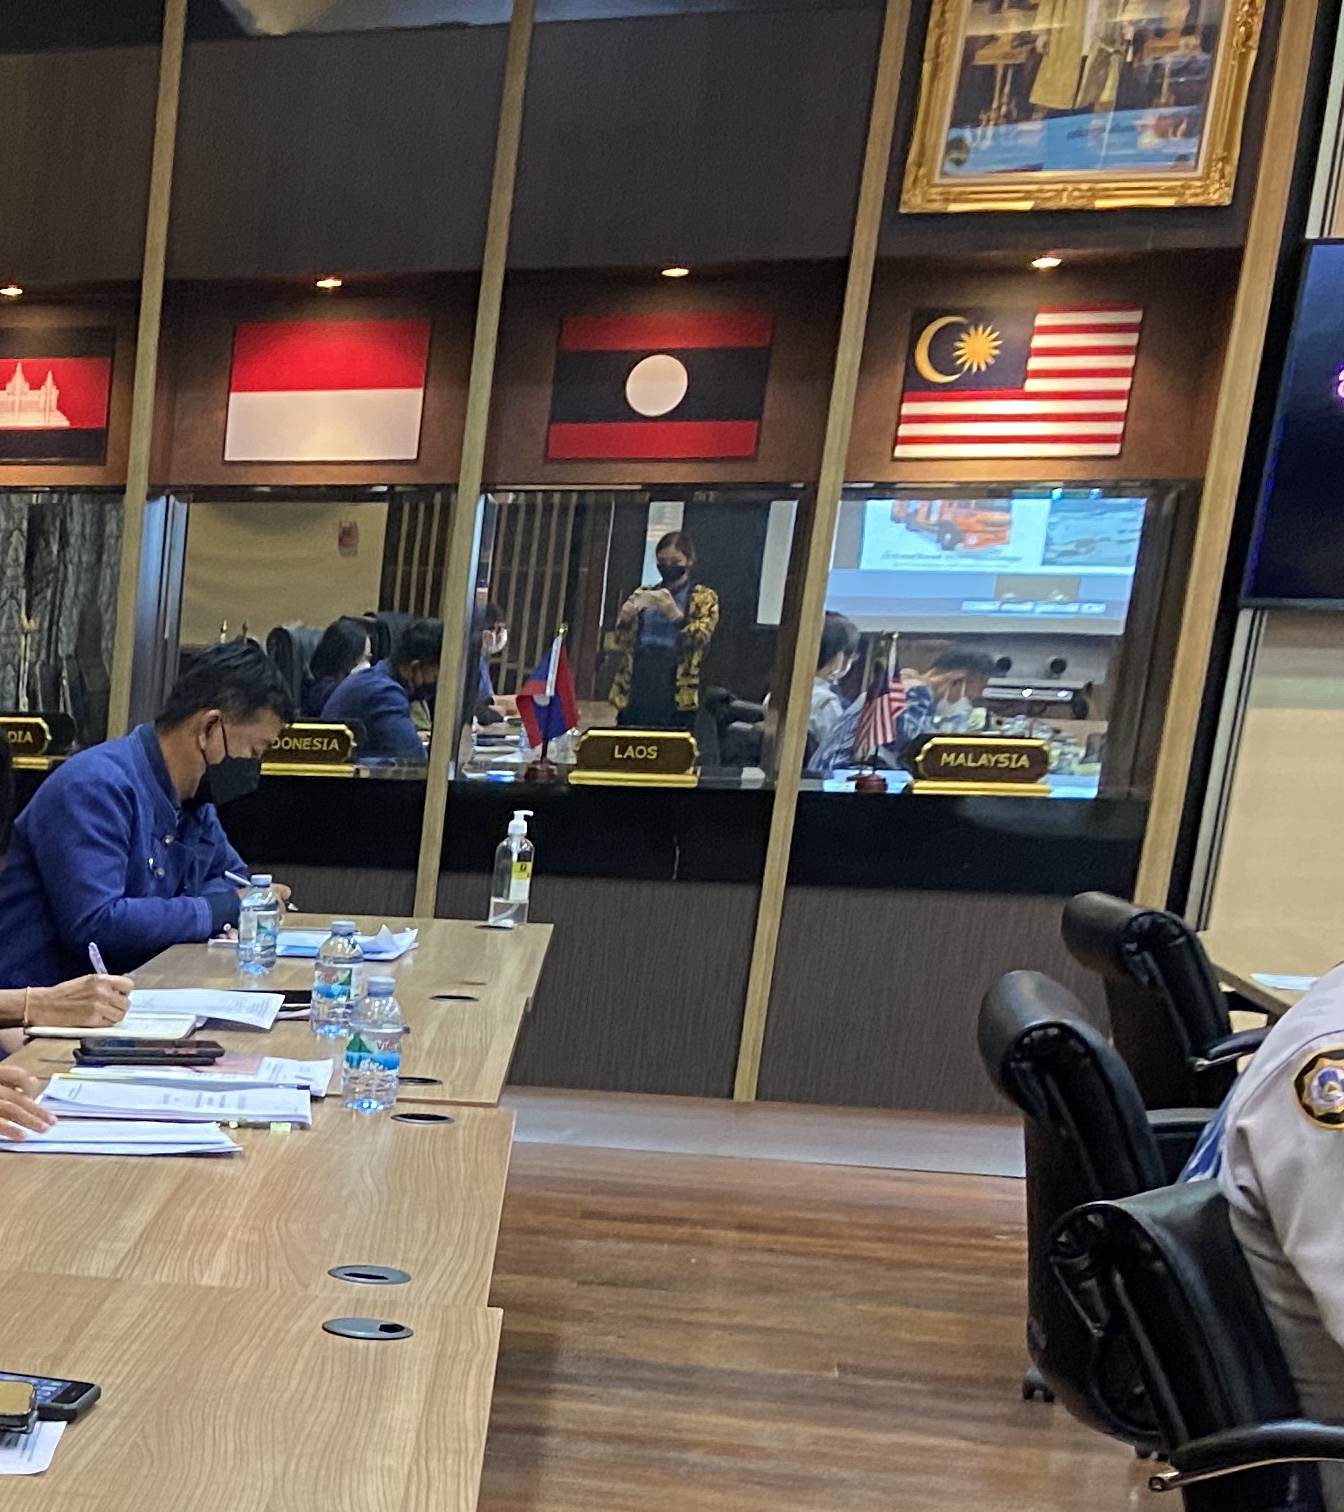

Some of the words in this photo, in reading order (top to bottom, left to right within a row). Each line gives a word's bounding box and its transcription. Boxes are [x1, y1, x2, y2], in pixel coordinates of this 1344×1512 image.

[272, 737, 340, 751] DONESIA
[613, 745, 658, 759] LAOS
[940, 752, 1030, 768] MALAYSIA
